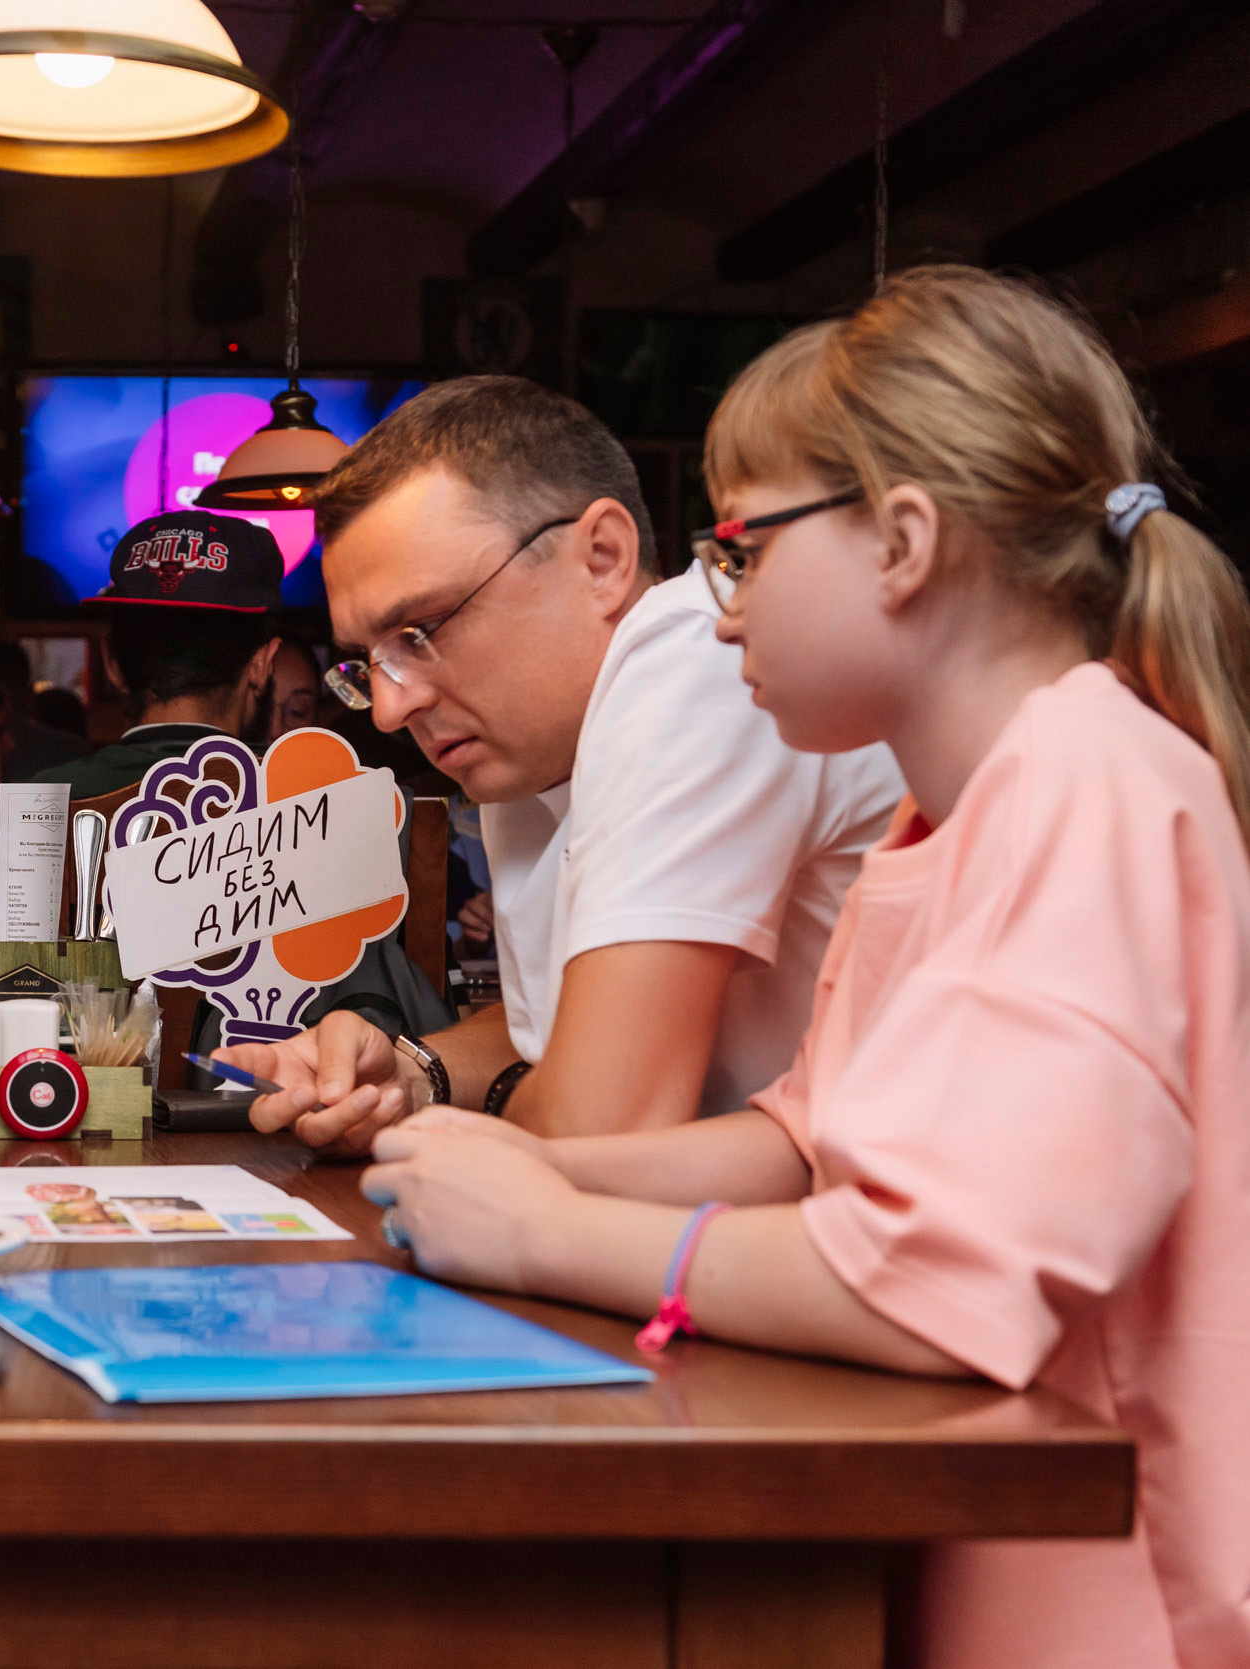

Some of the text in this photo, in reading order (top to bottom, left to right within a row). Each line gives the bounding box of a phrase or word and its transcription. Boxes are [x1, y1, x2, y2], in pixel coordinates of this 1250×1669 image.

[155, 528, 204, 538] CHICAGO
[124, 535, 229, 572] BULLS
[154, 793, 329, 884] СИДИМ
[224, 860, 276, 897] БЕЗ
[194, 880, 307, 948] ДИМ
[13, 979, 41, 987] GRAND
